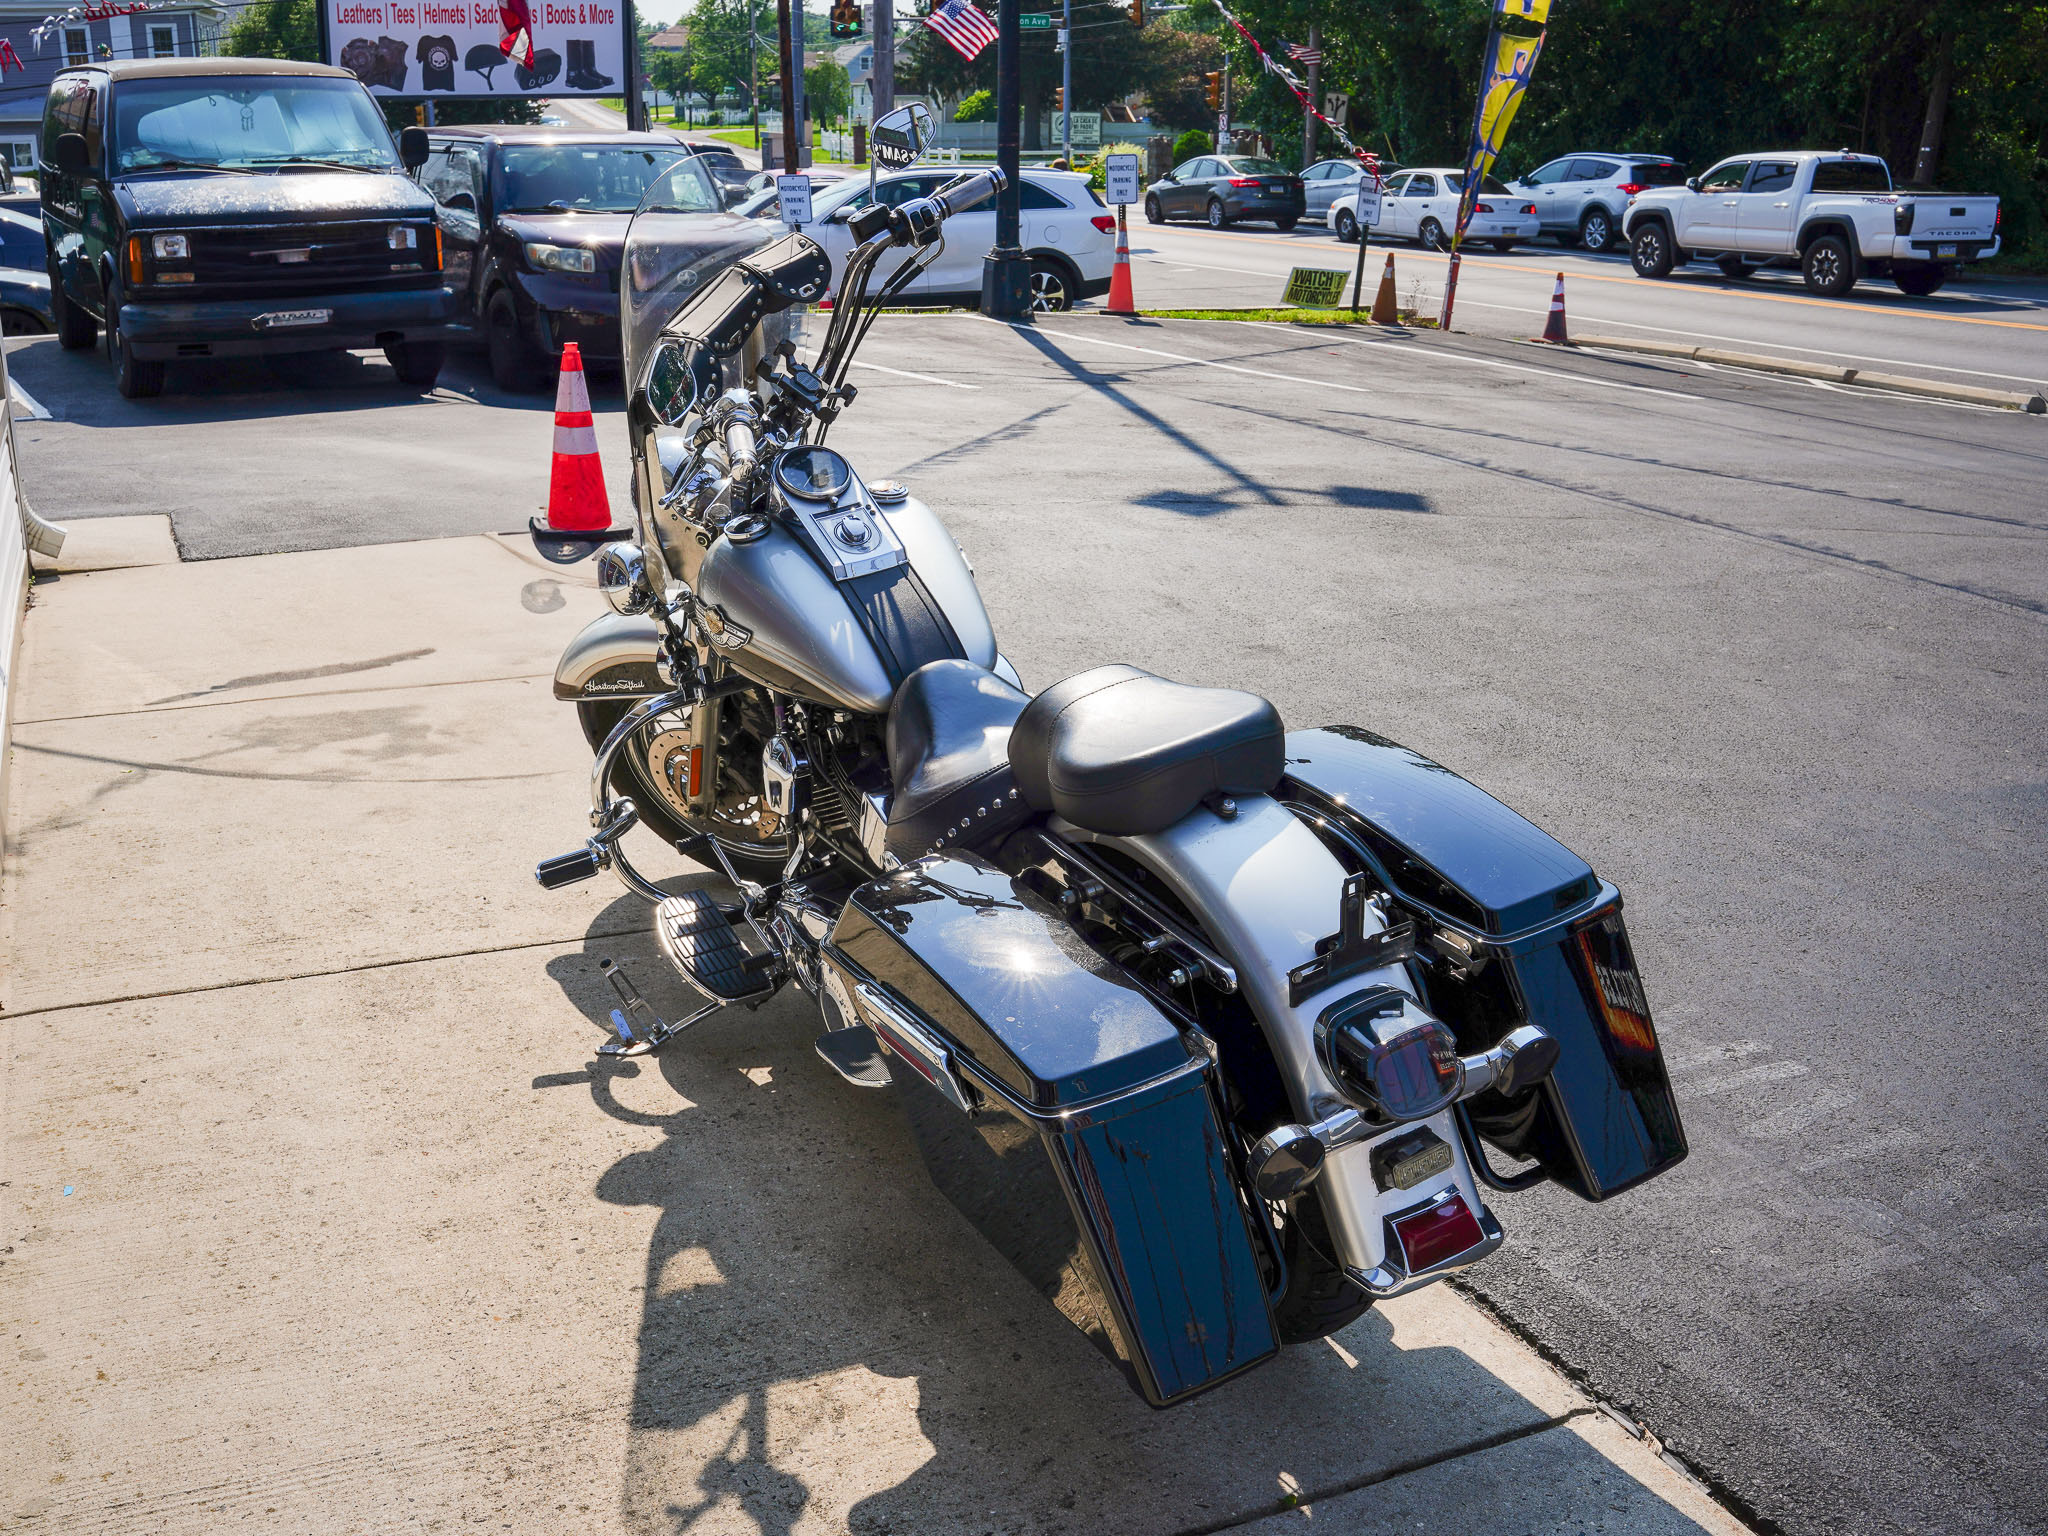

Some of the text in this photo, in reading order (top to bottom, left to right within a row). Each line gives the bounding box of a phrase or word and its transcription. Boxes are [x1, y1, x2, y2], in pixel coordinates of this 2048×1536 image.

[336, 3, 382, 24] Leathers
[390, 3, 415, 24] Tees
[423, 3, 466, 24] Helmets
[546, 4, 576, 24] Boots
[578, 4, 587, 24] &
[589, 4, 615, 24] More
[1032, 17, 1047, 25] Ave
[1293, 269, 1335, 287] WATCH
[1287, 287, 1341, 305] MOTORCYCLES
[584, 679, 645, 692] Heritage Softail
